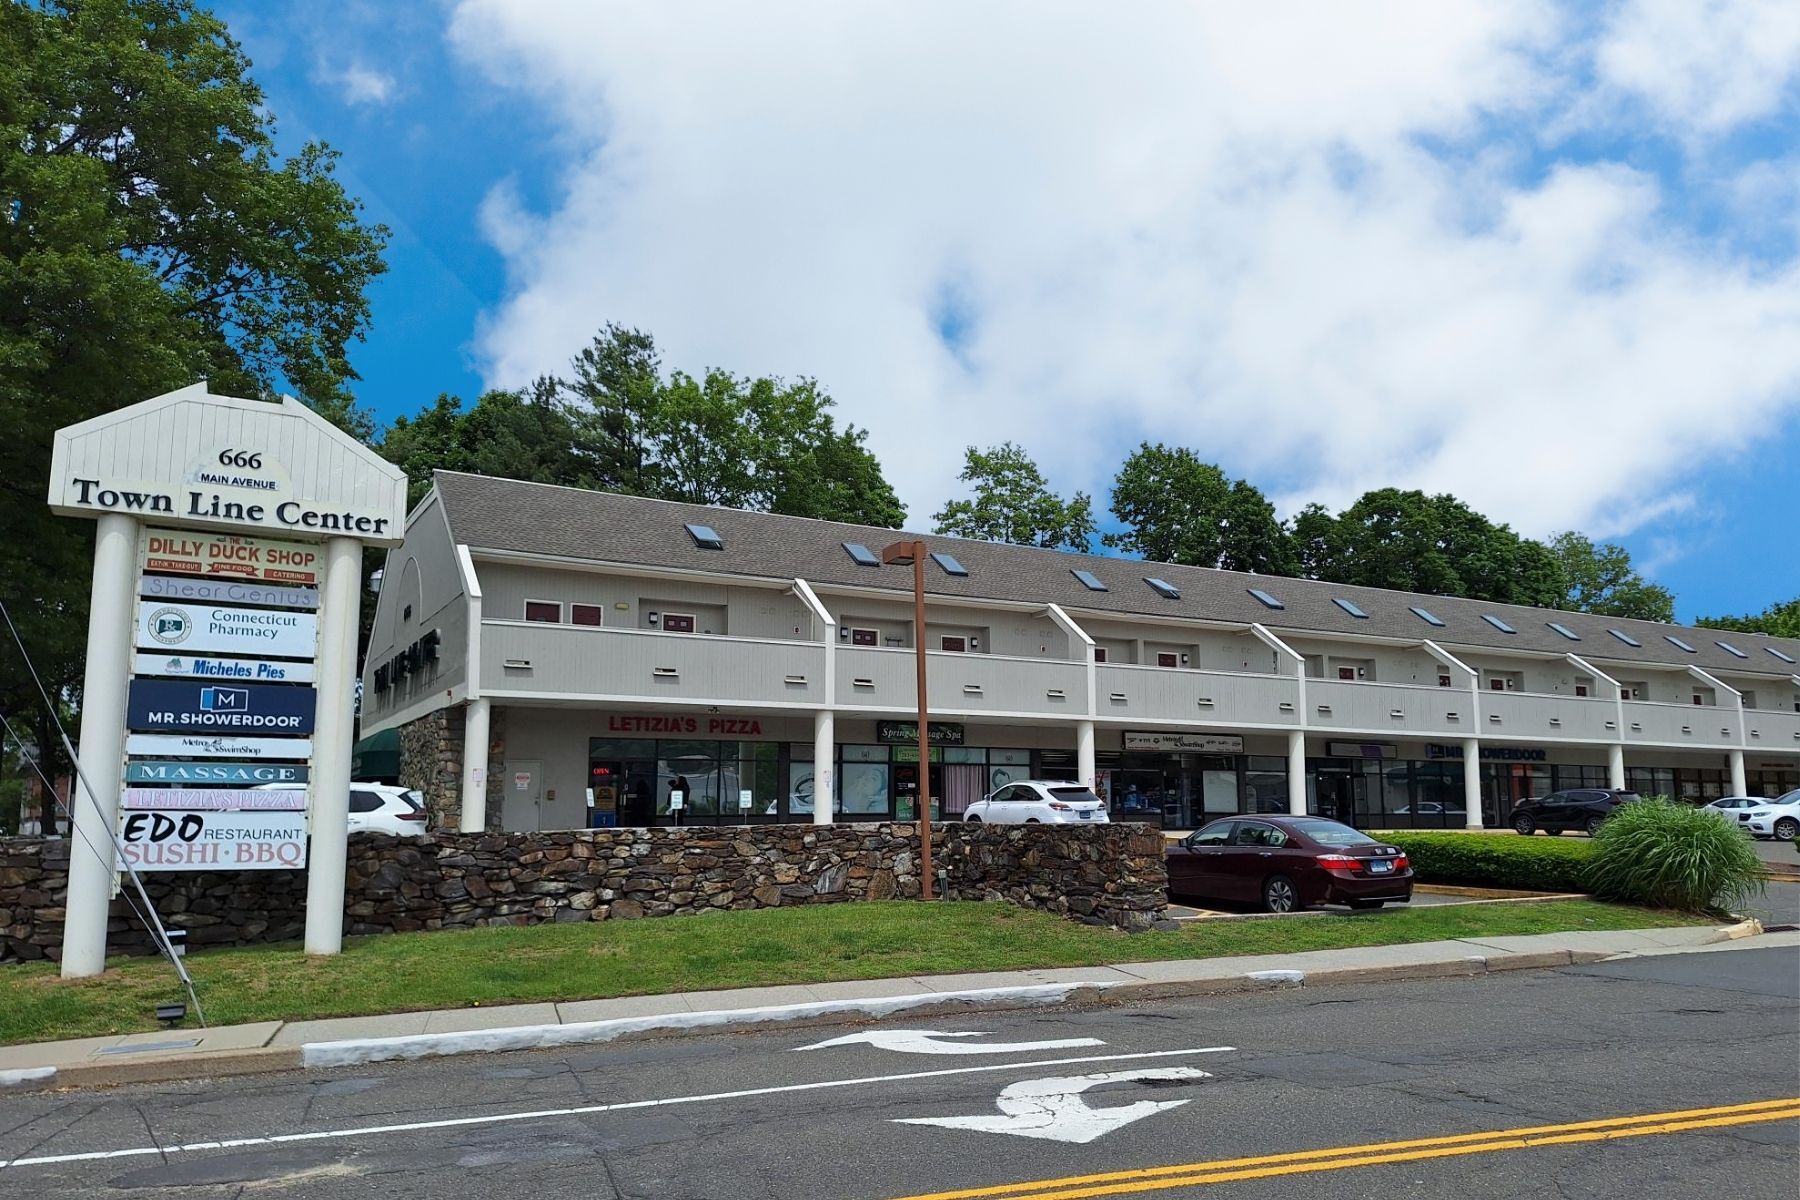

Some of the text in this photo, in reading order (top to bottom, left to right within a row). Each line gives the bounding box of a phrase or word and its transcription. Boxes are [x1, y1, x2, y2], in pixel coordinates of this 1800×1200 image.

[218, 448, 262, 470] 666
[200, 473, 277, 489] MAIN AVENUE
[72, 477, 389, 535] Town Line Center
[229, 537, 241, 545] THE
[148, 537, 315, 567] DILLY DUCK SHOP
[213, 563, 253, 572] FINE FOOD
[273, 571, 305, 579] CATERING
[151, 578, 311, 605] Shear Genius
[211, 610, 297, 627] Connecticut
[209, 623, 279, 639] Pharmacy
[192, 659, 286, 679] Micheles Pies
[218, 693, 235, 707] M
[609, 716, 762, 736] LETIZIA'S PIZZA
[882, 727, 961, 741] Spring Msage Spa
[182, 738, 208, 746] Metro
[140, 766, 296, 781] MASSAGE
[137, 790, 297, 807] LETIZIA'S PIZZA
[123, 813, 204, 843] EDO
[204, 829, 303, 840] RESTAURANT
[121, 842, 302, 867] SUSHI BBQ
